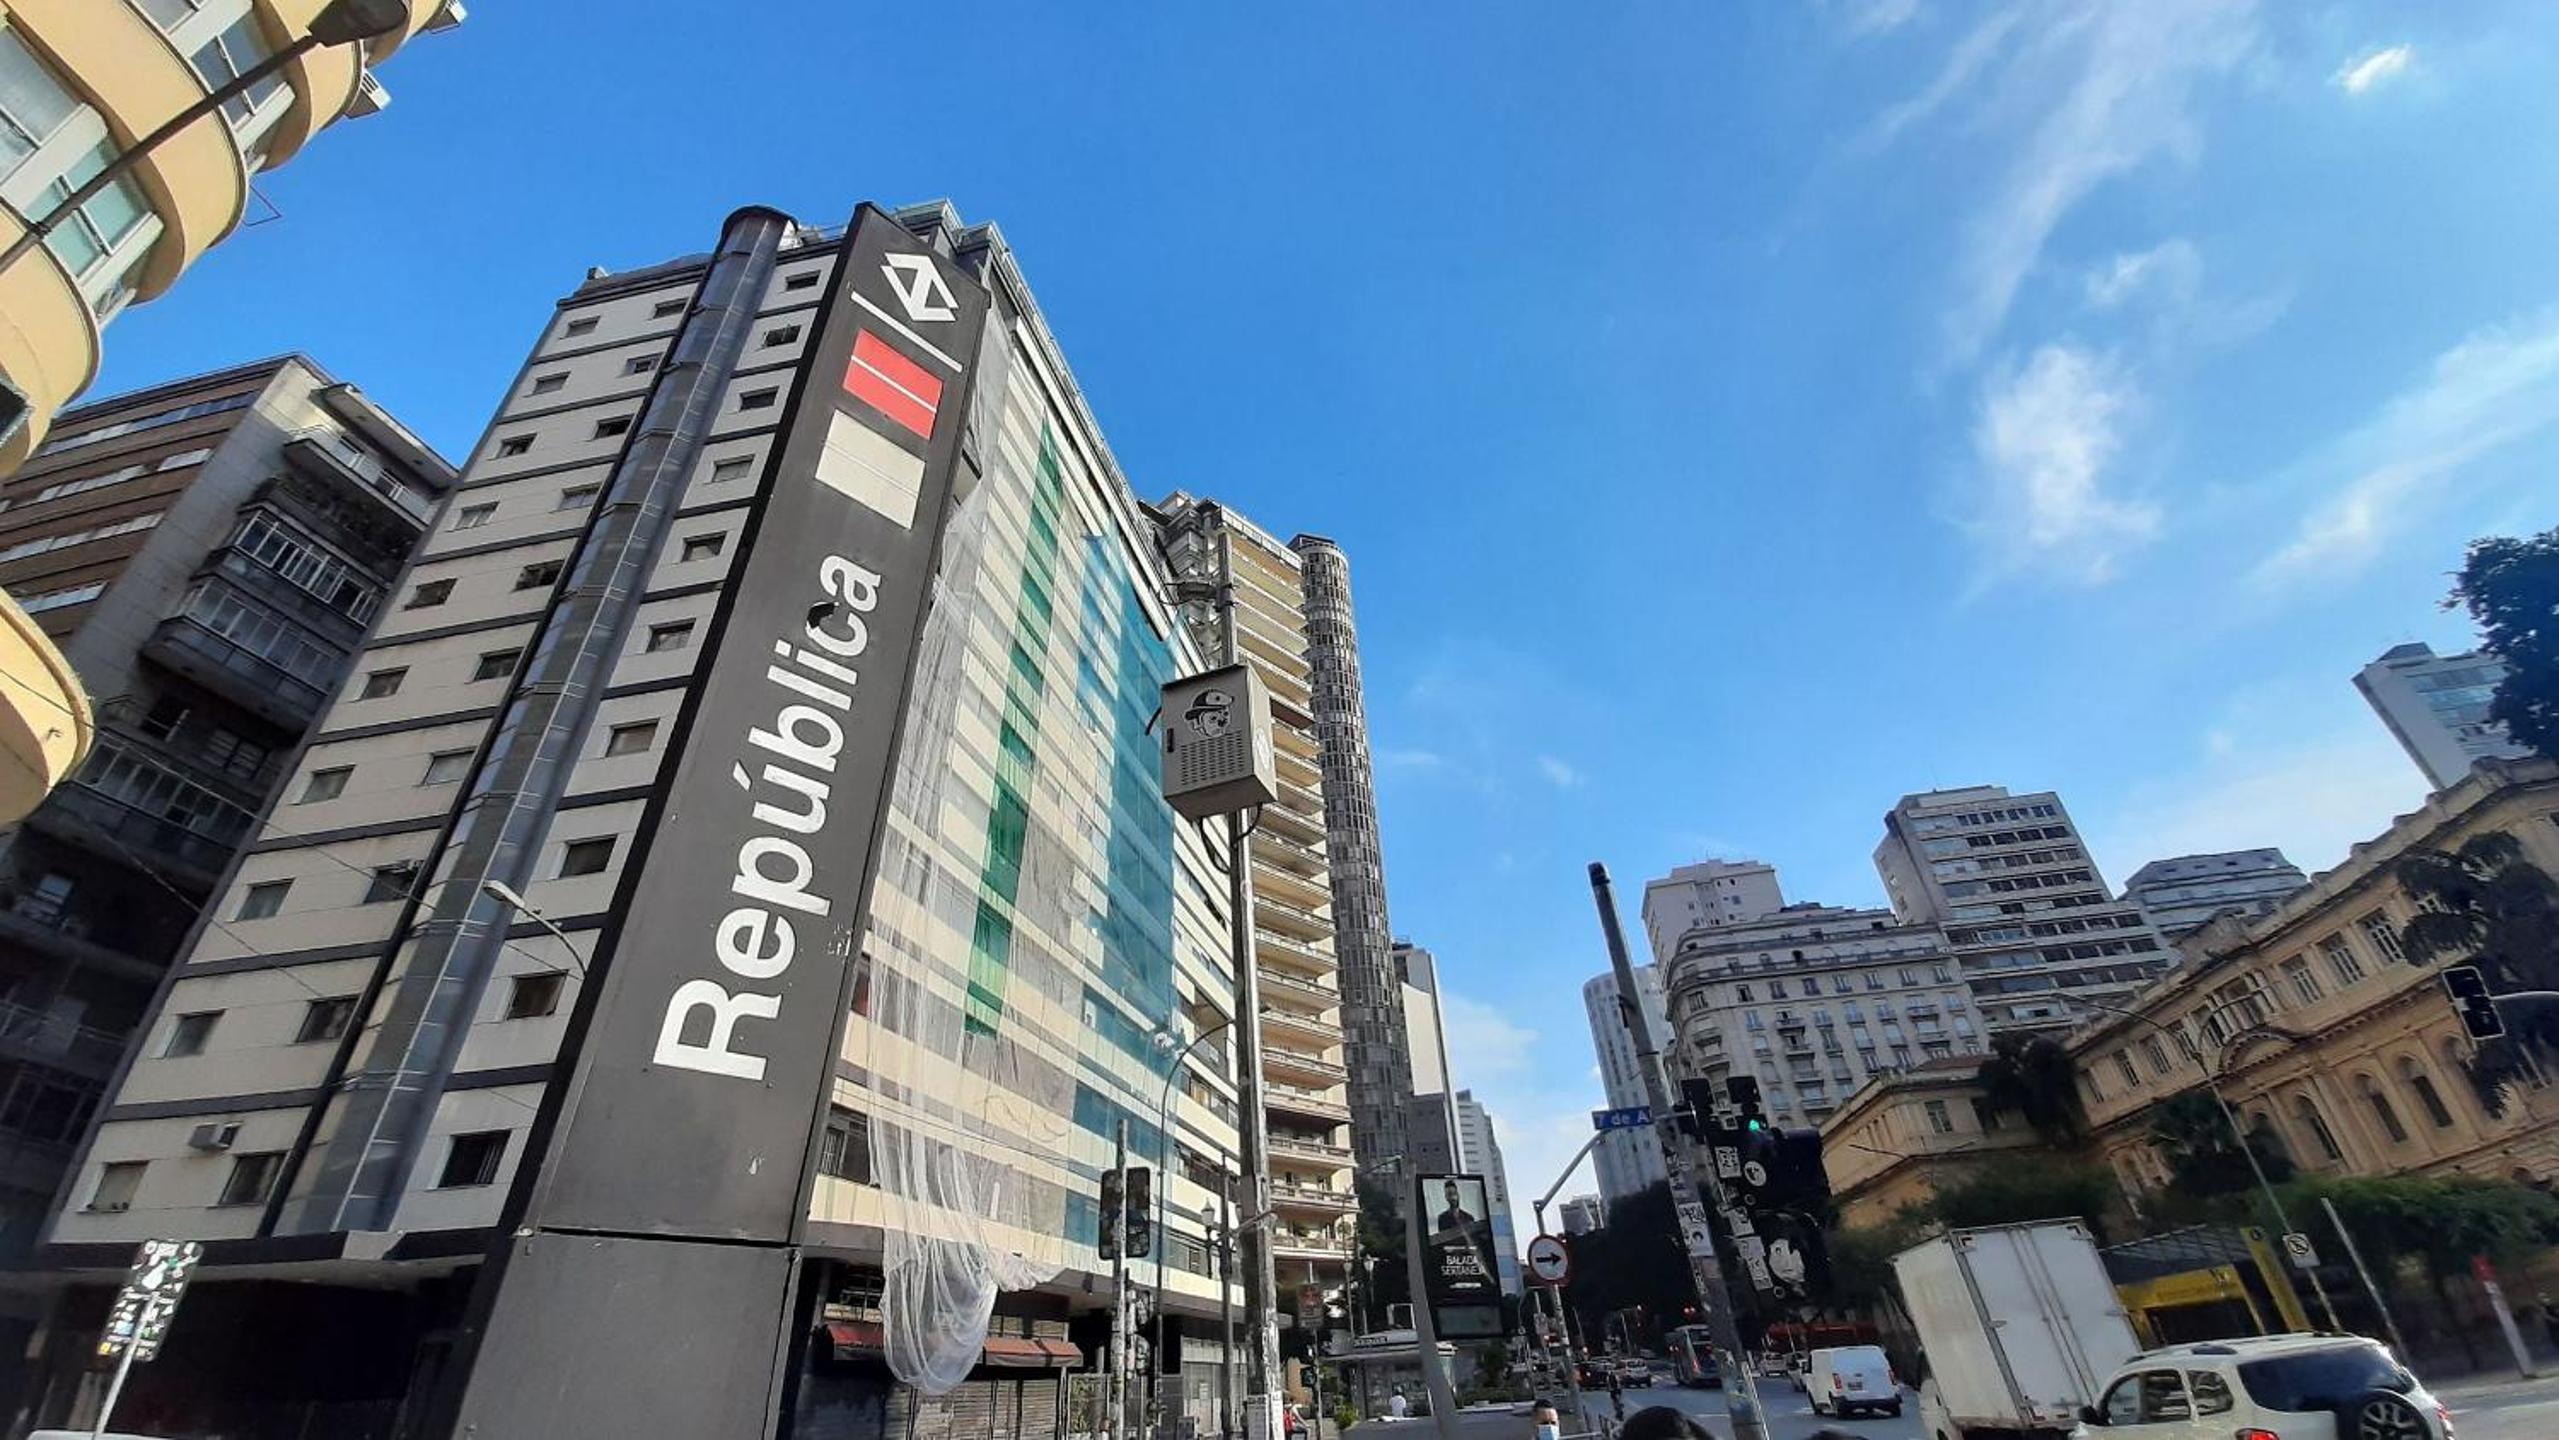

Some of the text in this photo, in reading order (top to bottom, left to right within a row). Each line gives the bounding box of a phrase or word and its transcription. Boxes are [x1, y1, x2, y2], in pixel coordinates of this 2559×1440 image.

[653, 553, 882, 1082] República
[1611, 1112, 1631, 1125] de
[1446, 1255, 1479, 1265] BALADA
